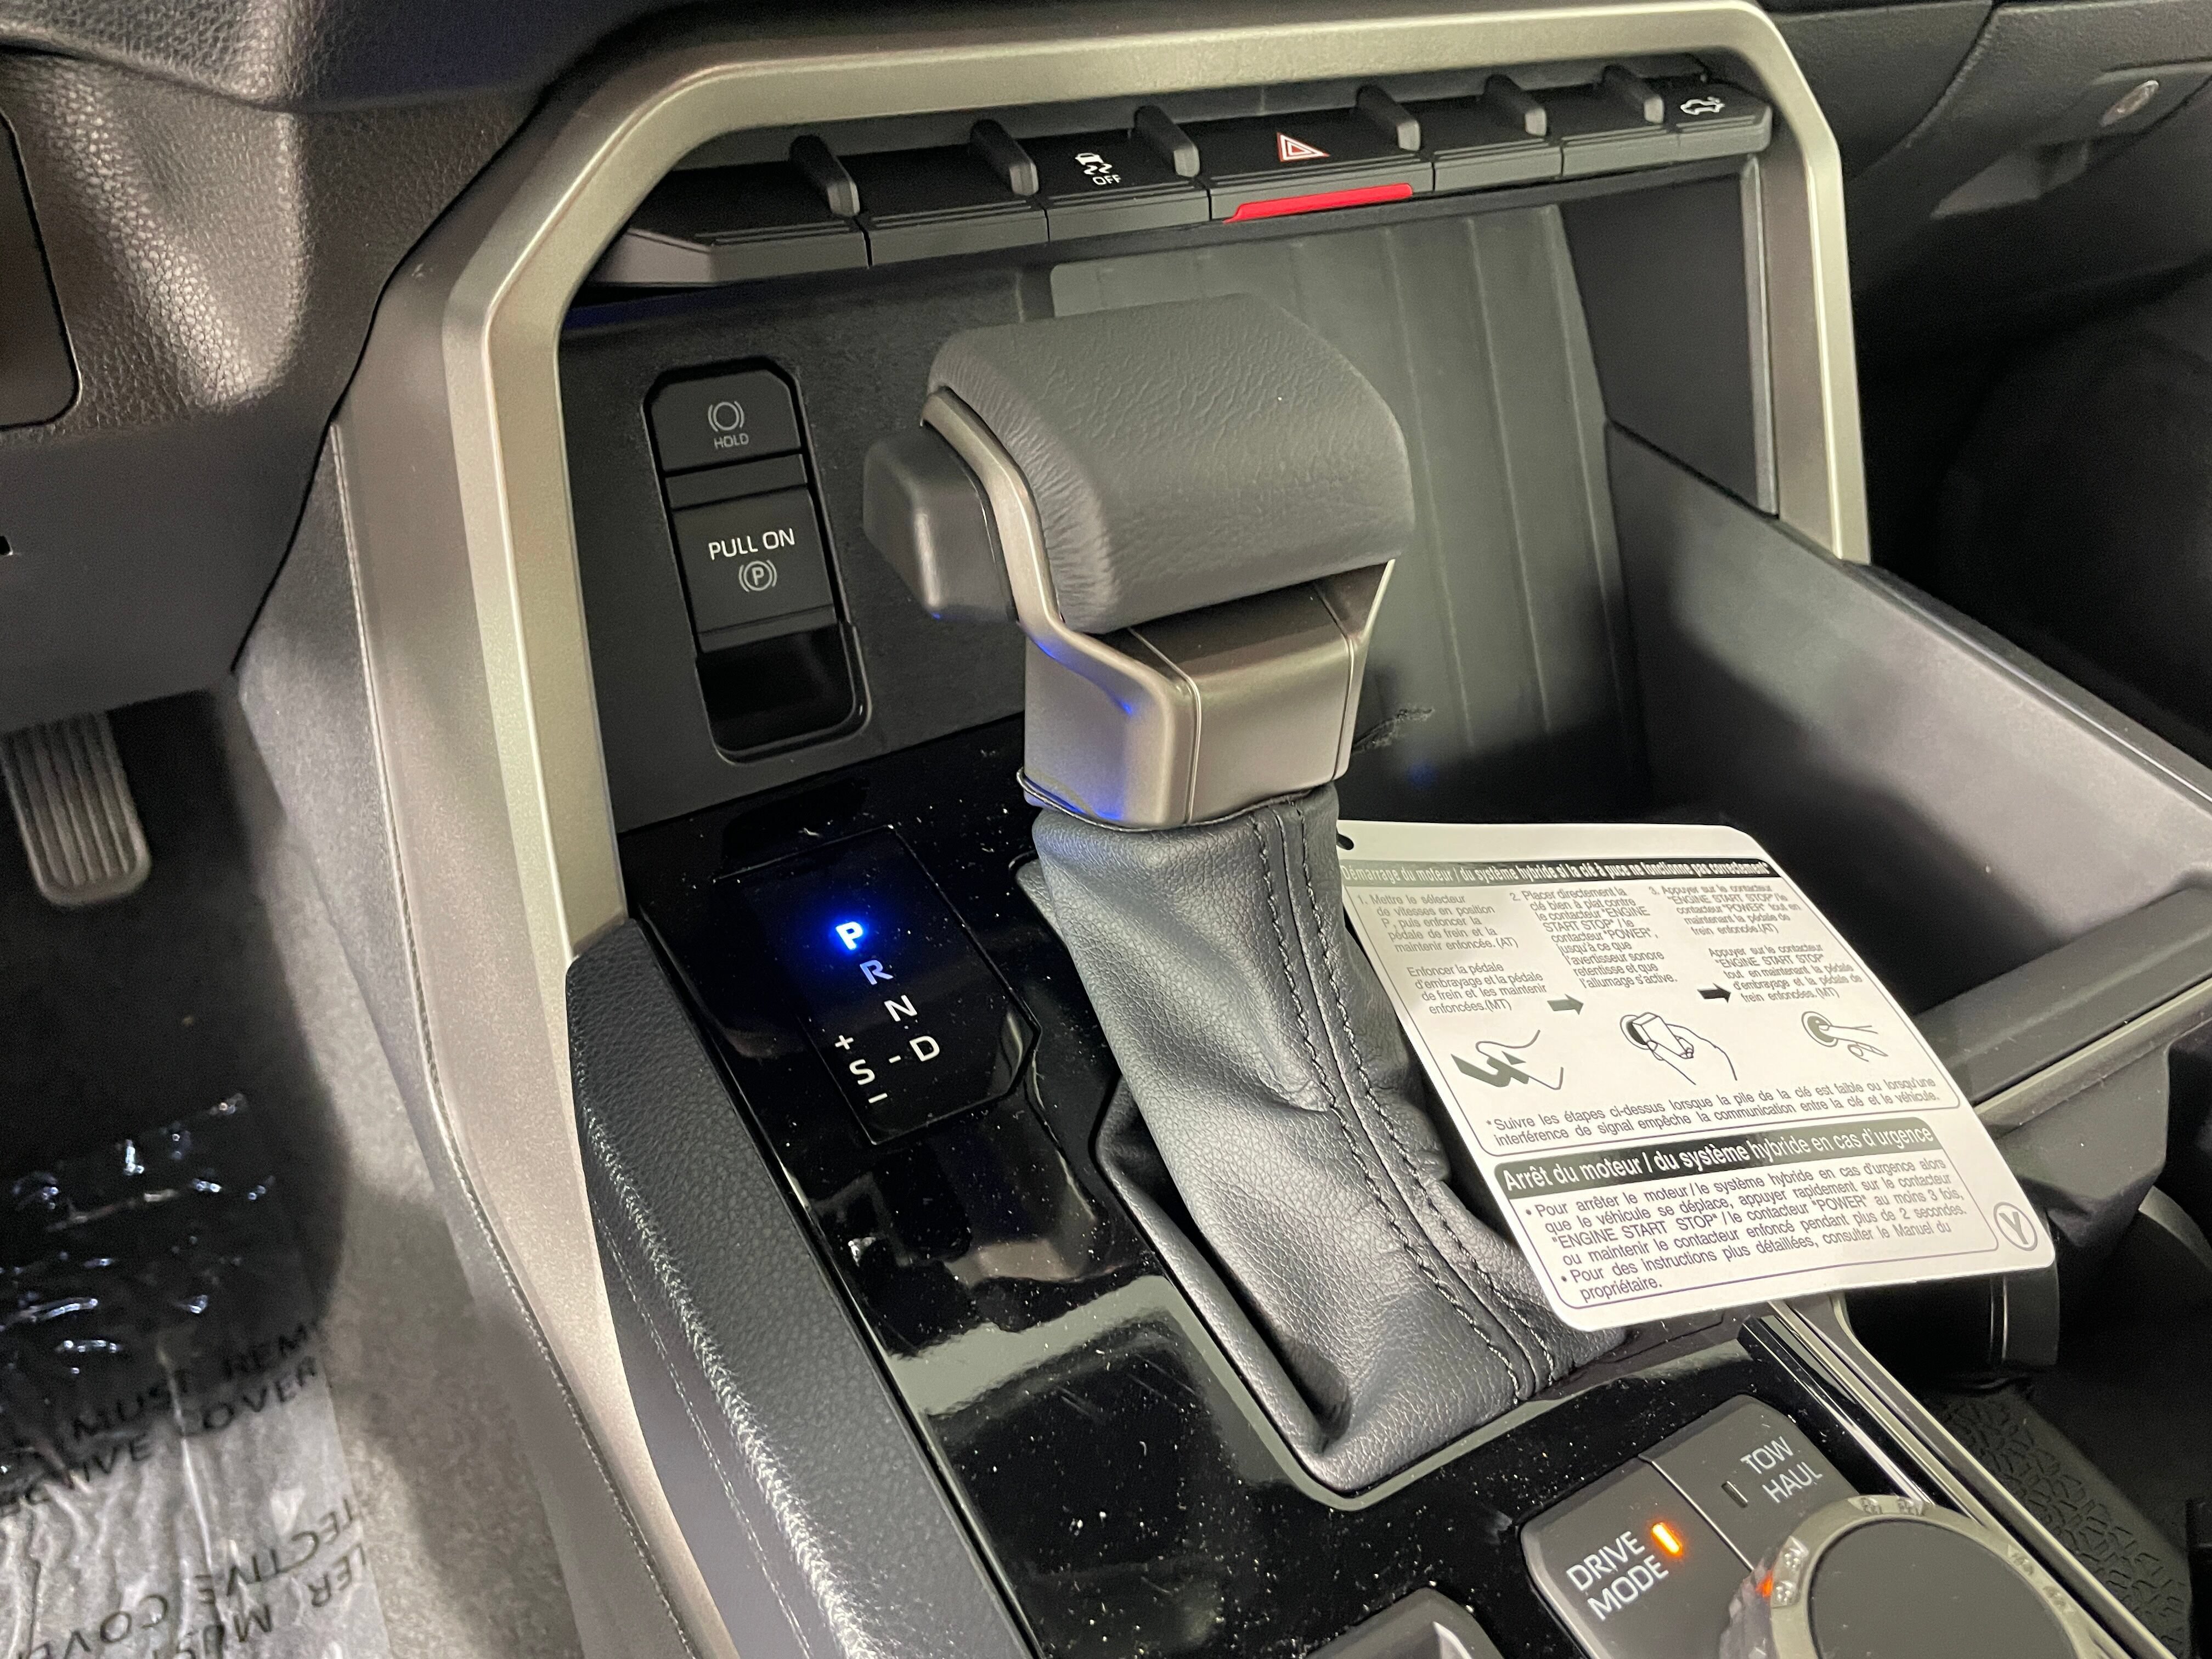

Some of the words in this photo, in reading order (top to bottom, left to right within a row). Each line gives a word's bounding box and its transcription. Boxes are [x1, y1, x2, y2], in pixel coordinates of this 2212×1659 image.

[1092, 173, 1121, 186] OFF
[713, 432, 750, 449] HOLD
[708, 535, 759, 560] PULL
[762, 527, 795, 550] ON
[1339, 864, 1401, 884] Démarrage
[1521, 890, 1555, 900] Placer
[1556, 887, 1616, 899] directement
[1613, 886, 1627, 895] la
[1530, 901, 1547, 911] clé
[1546, 900, 1572, 910] bien
[1572, 899, 1583, 909] à
[1583, 899, 1607, 910] plat
[1604, 898, 1636, 907] contre
[1534, 911, 1548, 921] le
[1548, 910, 1601, 920] contacteur
[1601, 906, 1650, 917] "ENGINE
[1542, 921, 1579, 932] START
[1580, 918, 1613, 930] STOP"
[1621, 918, 1634, 927] le
[835, 921, 864, 950] P
[1550, 932, 1604, 943] contacteur
[1556, 941, 1597, 956] jusqu'à
[1596, 943, 1611, 951] ce
[1611, 941, 1632, 952] que
[1562, 953, 1627, 965] l'avertisseur
[1628, 951, 1664, 961] sonore
[1572, 965, 1625, 976] retentisse
[1625, 963, 1638, 973] et
[1637, 963, 1658, 974] que
[859, 959, 894, 985] R
[1579, 977, 1635, 988] l'allumage
[1635, 973, 1677, 984] s'active.
[883, 995, 917, 1022] N
[909, 1035, 940, 1062] D
[849, 1059, 876, 1085] S
[1538, 1114, 1560, 1125] les
[1564, 1109, 1605, 1123] étapes
[1609, 1103, 1665, 1117] ci-dessus
[1668, 1098, 1713, 1110] lorsque
[1716, 1094, 1731, 1105] la
[1733, 1092, 1754, 1106] pile
[1758, 1090, 1774, 1101] de
[1776, 1088, 1791, 1099] la
[1795, 1086, 1812, 1097] clé
[1815, 1085, 1834, 1096] est
[1833, 1081, 1864, 1093] faible
[1866, 1082, 1882, 1091] ou
[1882, 1077, 1936, 1090] lorsqu'une
[1493, 1128, 1569, 1146] interférence
[1575, 1124, 1592, 1136] de
[1597, 1119, 1634, 1135] signal
[1637, 1113, 1691, 1130] empêche
[1695, 1111, 1711, 1122] la
[1713, 1104, 1796, 1120] communication
[1799, 1099, 1829, 1111] entre
[1829, 1097, 1844, 1108] la
[1847, 1095, 1864, 1107] clé
[1867, 1094, 1881, 1105] et
[1879, 1093, 1893, 1104] le
[1894, 1090, 1939, 1103] véhicule.
[1503, 1165, 1553, 1190] Arrêt
[1553, 1163, 1579, 1183] du
[1578, 1158, 1643, 1180] moteur
[1654, 1150, 1680, 1171] du
[1679, 1143, 1750, 1171] système
[1746, 1135, 1811, 1163] hybride
[1810, 1136, 1834, 1152] en
[1832, 1133, 1862, 1149] cas
[1861, 1121, 1933, 1149] d'urgence
[1534, 1203, 1568, 1217] Pour
[1576, 1195, 1620, 1211] arrêter
[1622, 1192, 1638, 1204] le
[1643, 1187, 1688, 1201] moteur
[1694, 1182, 1709, 1194] le
[1713, 1177, 1765, 1194] système
[1767, 1169, 1814, 1187] hybride
[1818, 1169, 1836, 1179] en
[1839, 1166, 1861, 1177] cas
[1863, 1161, 1915, 1176] d'urgence
[1919, 1158, 1946, 1170] alors
[1545, 1220, 1572, 1235] que
[1576, 1215, 1592, 1228] le
[1595, 1206, 1651, 1224] véhicule
[1657, 1205, 1674, 1216] se
[1679, 1198, 1734, 1214] déplace,
[1738, 1190, 1787, 1207] appuyer
[1792, 1180, 1858, 1199] rapidement
[1860, 1180, 1880, 1190] sur
[1880, 1176, 1895, 1189] le
[1898, 1173, 1951, 1187] contacteur
[1551, 1228, 1618, 1248] "ENGINE
[1621, 1220, 1667, 1238] START
[1675, 1213, 1717, 1231] STOP"
[1726, 1211, 1742, 1223] le
[1746, 1204, 1809, 1221] contacteur
[1811, 1194, 1866, 1211] "POWER"
[1874, 1195, 1890, 1205] au
[1893, 1190, 1926, 1204] moins
[1927, 1189, 1938, 1201] 3
[1938, 1187, 1964, 1200] fois,
[1562, 1254, 1582, 1265] ou
[1588, 1240, 1650, 1262] maintenir
[1652, 1238, 1668, 1251] le
[1673, 1229, 1739, 1248] contacteur
[1746, 1219, 1795, 1238] enfoncé
[1799, 1213, 1849, 1233] pendant
[1852, 1211, 1877, 1227] plus
[1880, 1208, 1896, 1221] de
[1899, 1207, 1910, 1219] 2
[1913, 1203, 1967, 1218] secondes.
[1999, 1211, 2029, 1245] Y
[1569, 1268, 1604, 1283] Pour
[1611, 1262, 1638, 1276] des
[1640, 1251, 1717, 1271] instructions
[1722, 1245, 1751, 1262] plus
[1756, 1235, 1819, 1254] détaillées,
[1822, 1227, 1874, 1244] consulter
[1876, 1225, 1890, 1238] le
[1892, 1221, 1934, 1237] Manuel
[1936, 1220, 1951, 1233] du
[1579, 1277, 1662, 1303] propriétaire.
[1739, 1435, 1796, 1475] TOW
[1761, 1461, 1824, 1504] HAUL
[1566, 1530, 1646, 1592] DRIVE
[1586, 1554, 1669, 1621] MODE
